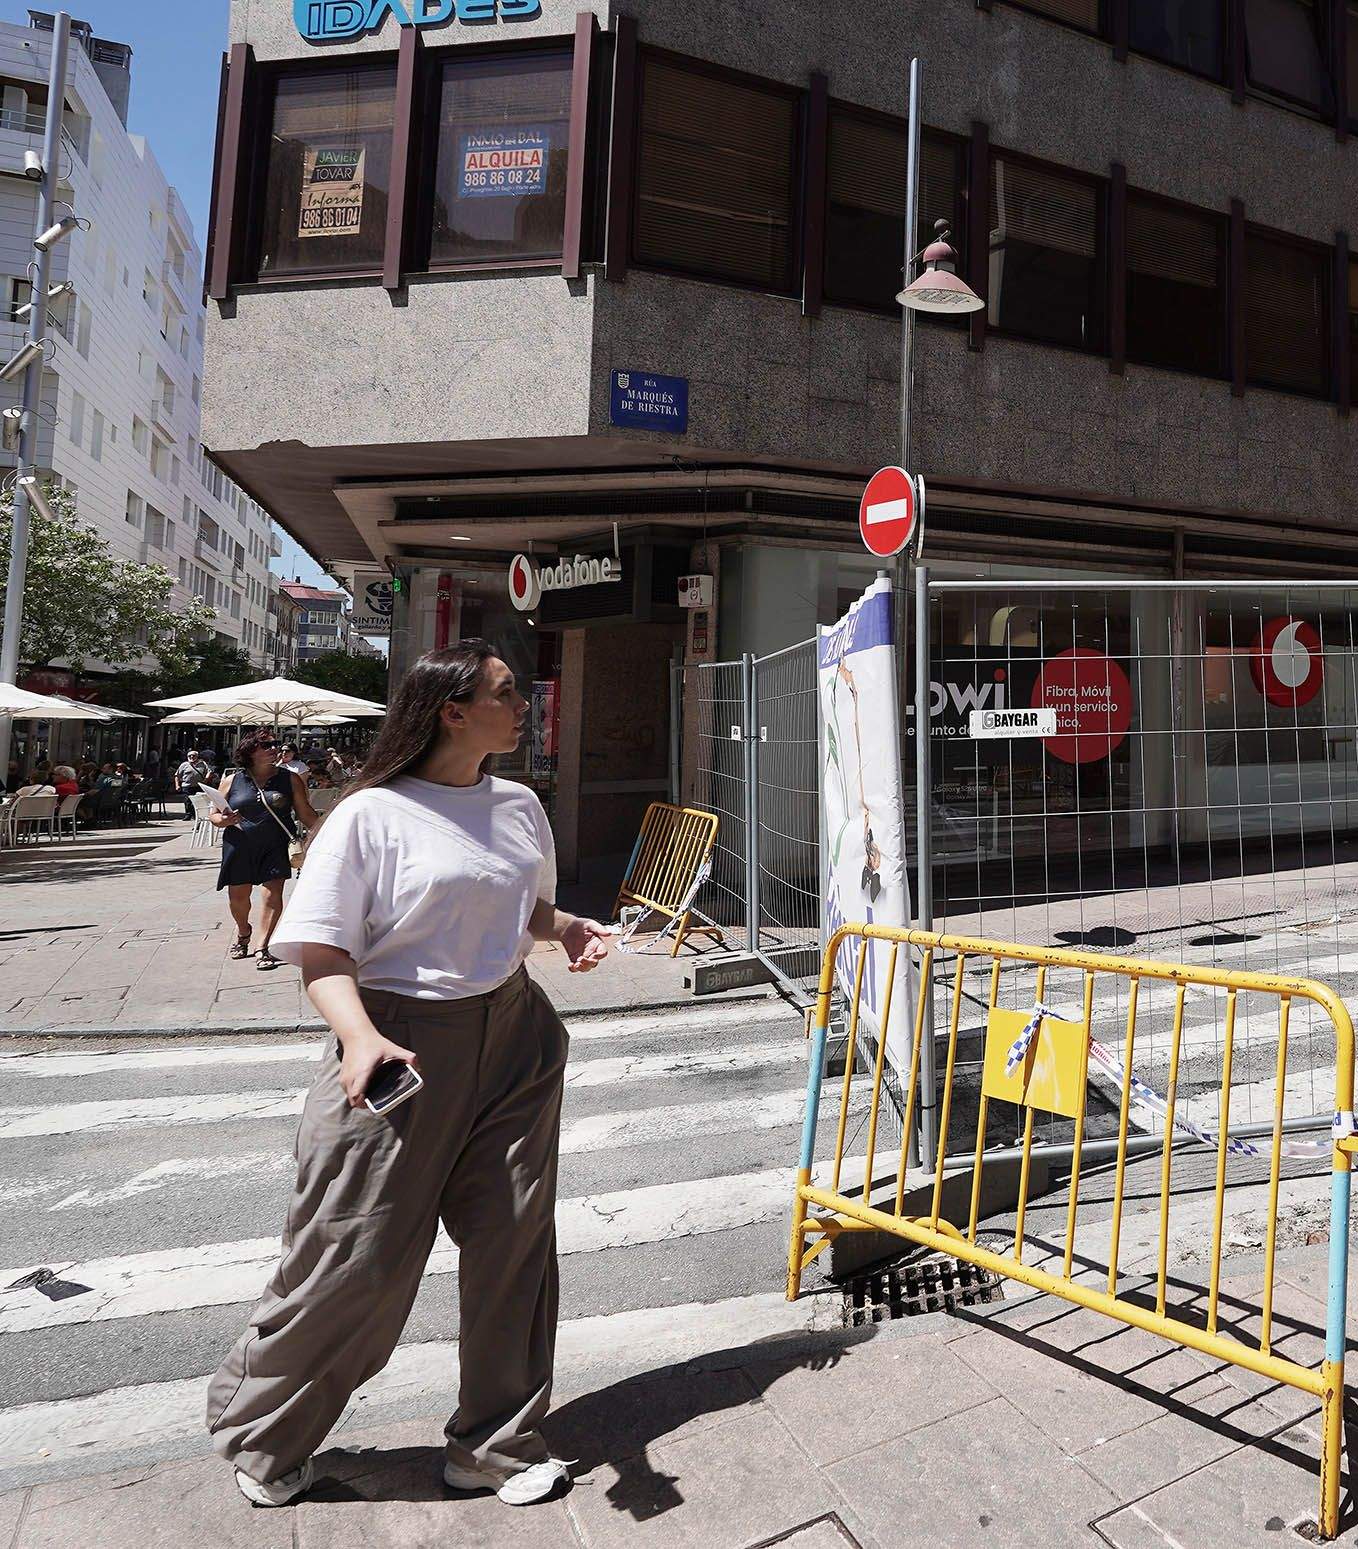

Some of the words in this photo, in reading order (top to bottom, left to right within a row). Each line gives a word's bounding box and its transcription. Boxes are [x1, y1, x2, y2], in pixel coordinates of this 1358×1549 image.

[319, 150, 357, 163] JAVIER
[466, 150, 541, 169] ALQUILA
[315, 167, 353, 180] TOVAR
[464, 173, 487, 187] 986
[489, 171, 505, 185] 86
[508, 170, 522, 184] 08
[525, 169, 541, 183] 24
[307, 191, 360, 208] Informa
[303, 209, 321, 228] 986
[627, 389, 674, 404] MARQUÉS
[621, 400, 634, 411] DE
[638, 402, 679, 416] RIESTRA
[534, 554, 614, 592] vodafone
[1046, 685, 1078, 697] Fibra,
[1081, 684, 1111, 697] Móvil
[1056, 703, 1071, 712] un
[1074, 700, 1118, 712] servicio
